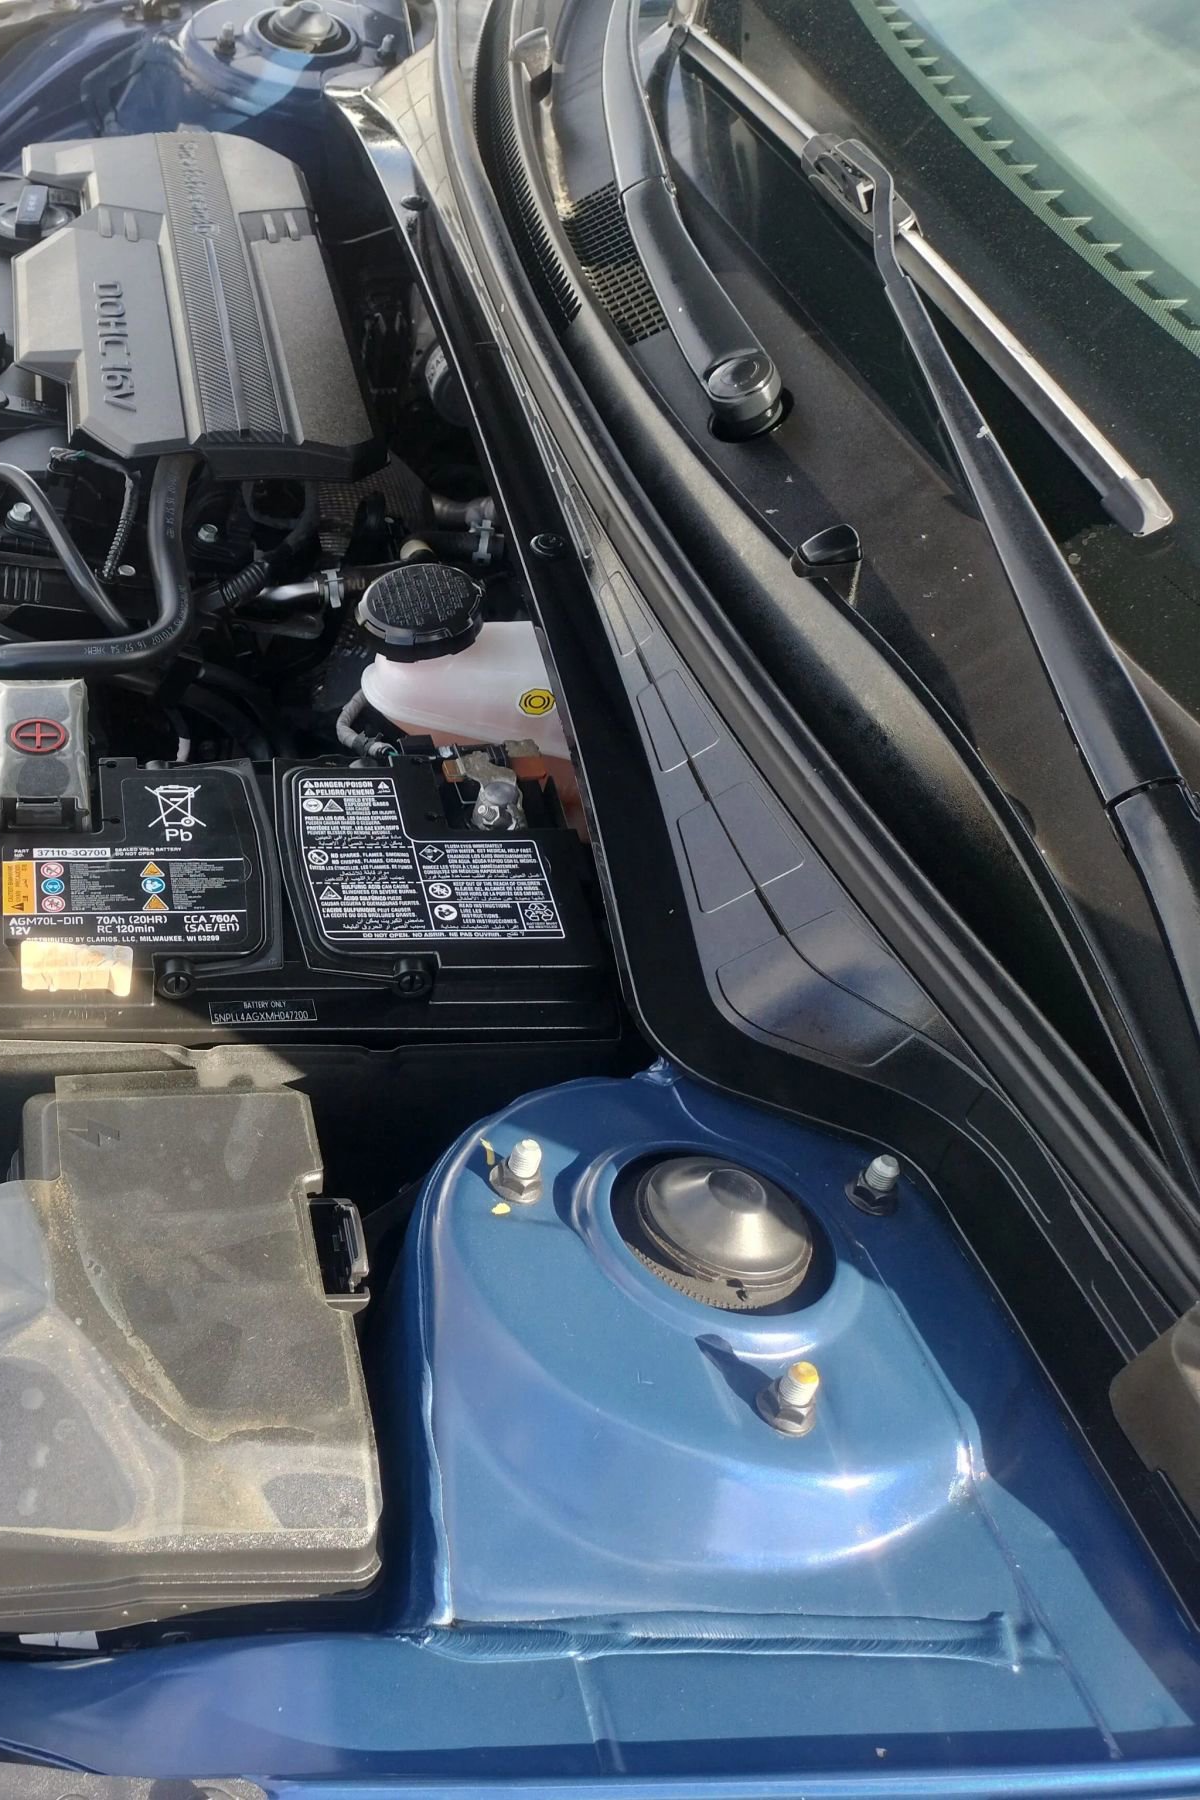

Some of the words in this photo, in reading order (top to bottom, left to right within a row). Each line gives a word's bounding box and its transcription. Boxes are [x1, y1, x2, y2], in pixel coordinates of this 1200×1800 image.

[94, 280, 131, 356] DOHC
[101, 361, 138, 412] 16V
[165, 829, 192, 842] Pb
[96, 916, 124, 924] 70Ah
[129, 915, 168, 925] (20HR)
[183, 915, 207, 924] CCA
[210, 914, 239, 923] 760A
[10, 926, 31, 936] 12V
[97, 925, 113, 933] RC
[116, 925, 155, 933] 120min
